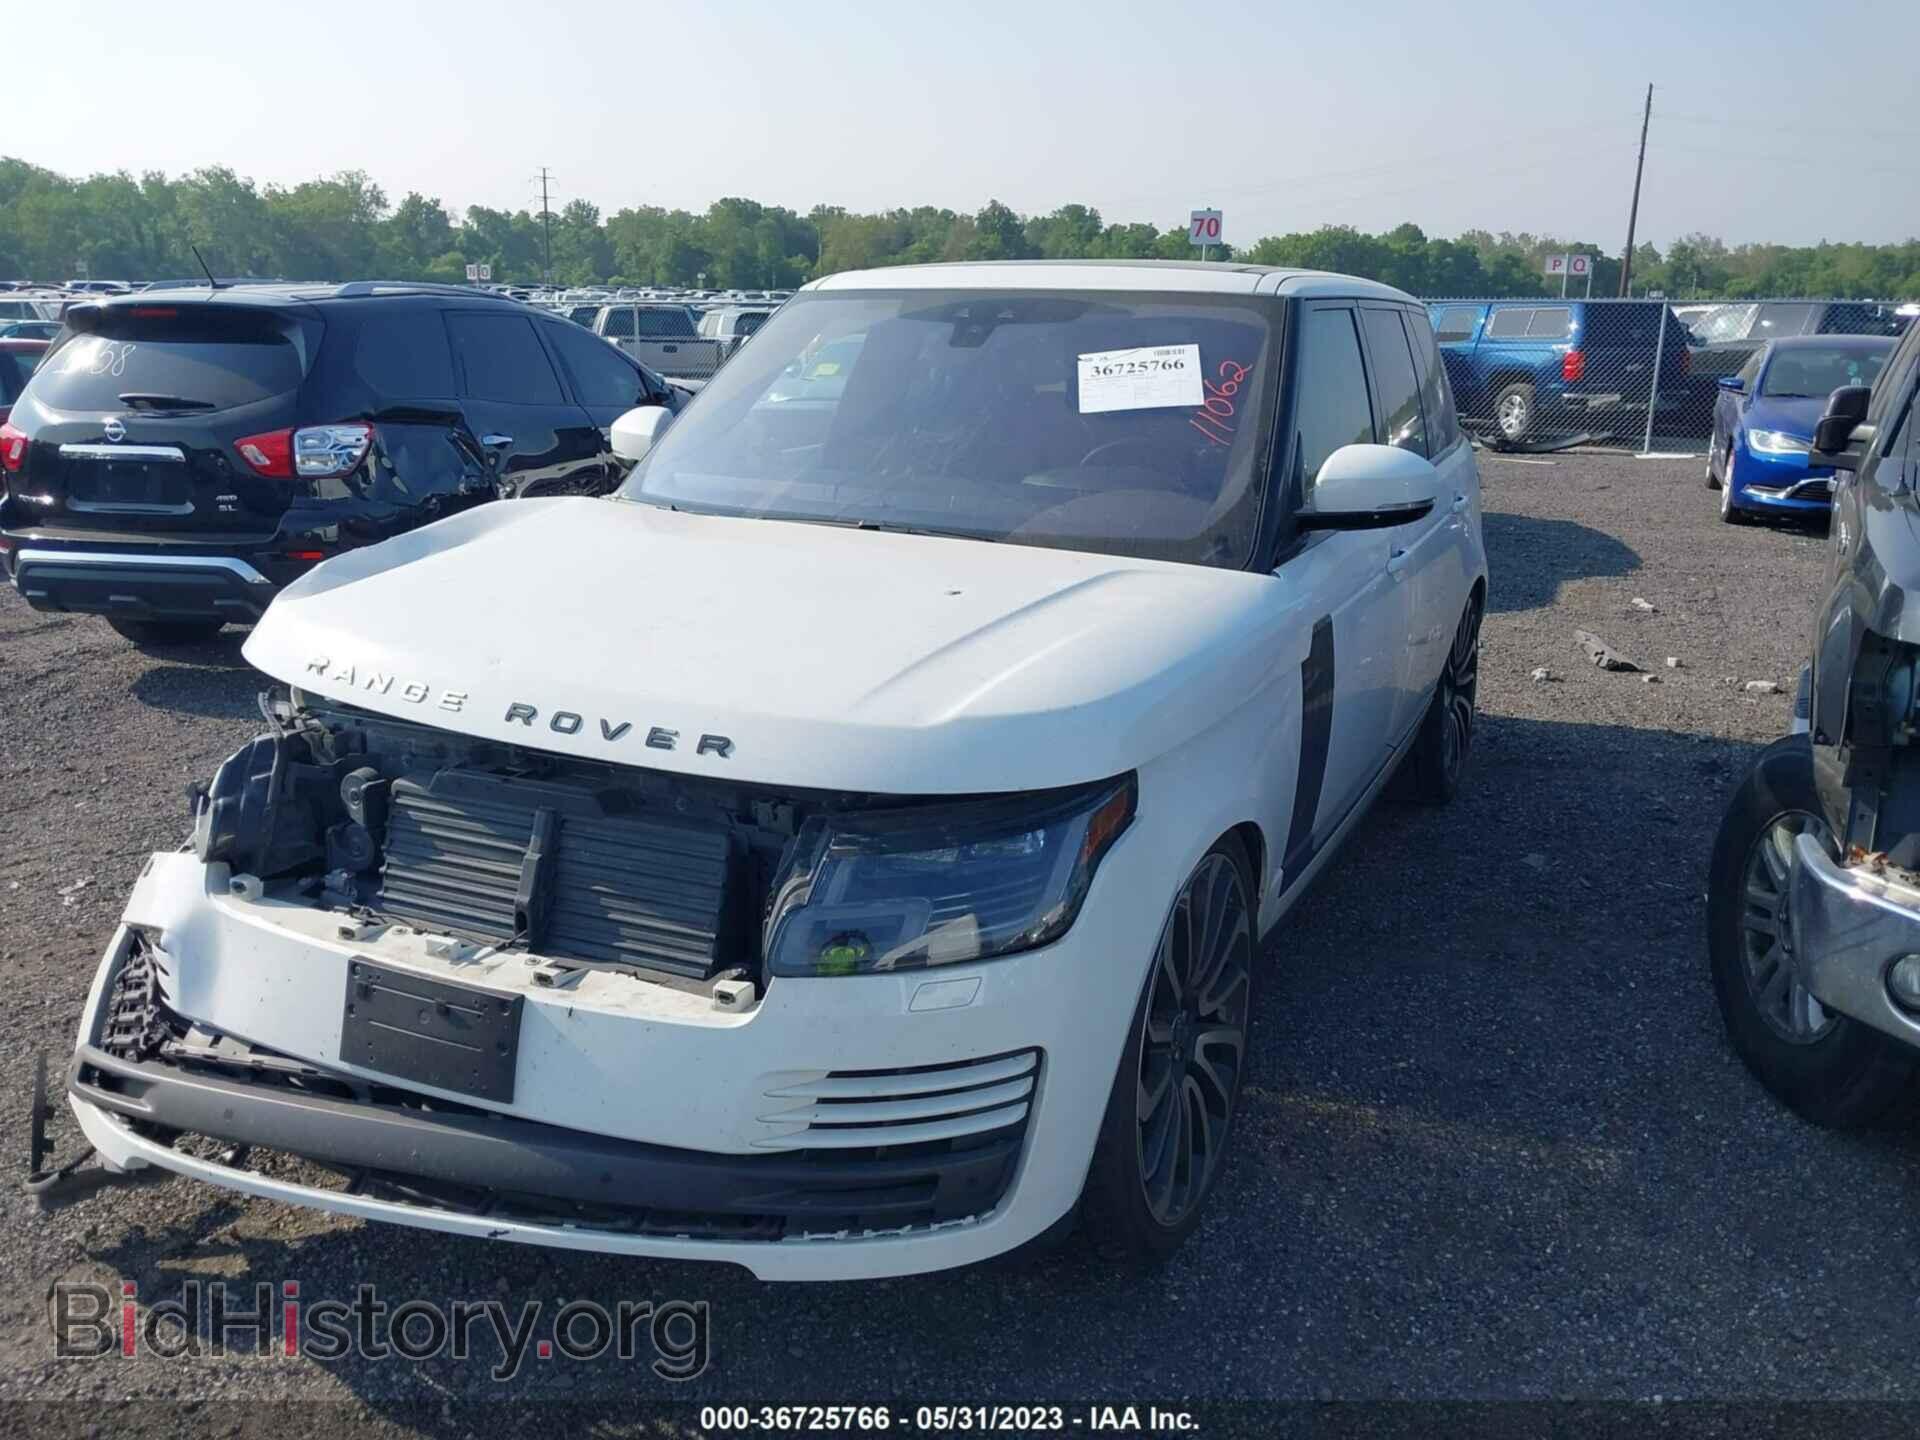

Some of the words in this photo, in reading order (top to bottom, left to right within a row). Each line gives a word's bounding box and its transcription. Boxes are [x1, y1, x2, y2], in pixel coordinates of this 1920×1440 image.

[1193, 217, 1220, 238] 70
[1552, 259, 1562, 271] P
[1573, 257, 1586, 272] Q
[1090, 358, 1185, 378] 36725766
[307, 656, 468, 712] RANGE
[504, 701, 735, 759] ROVER
